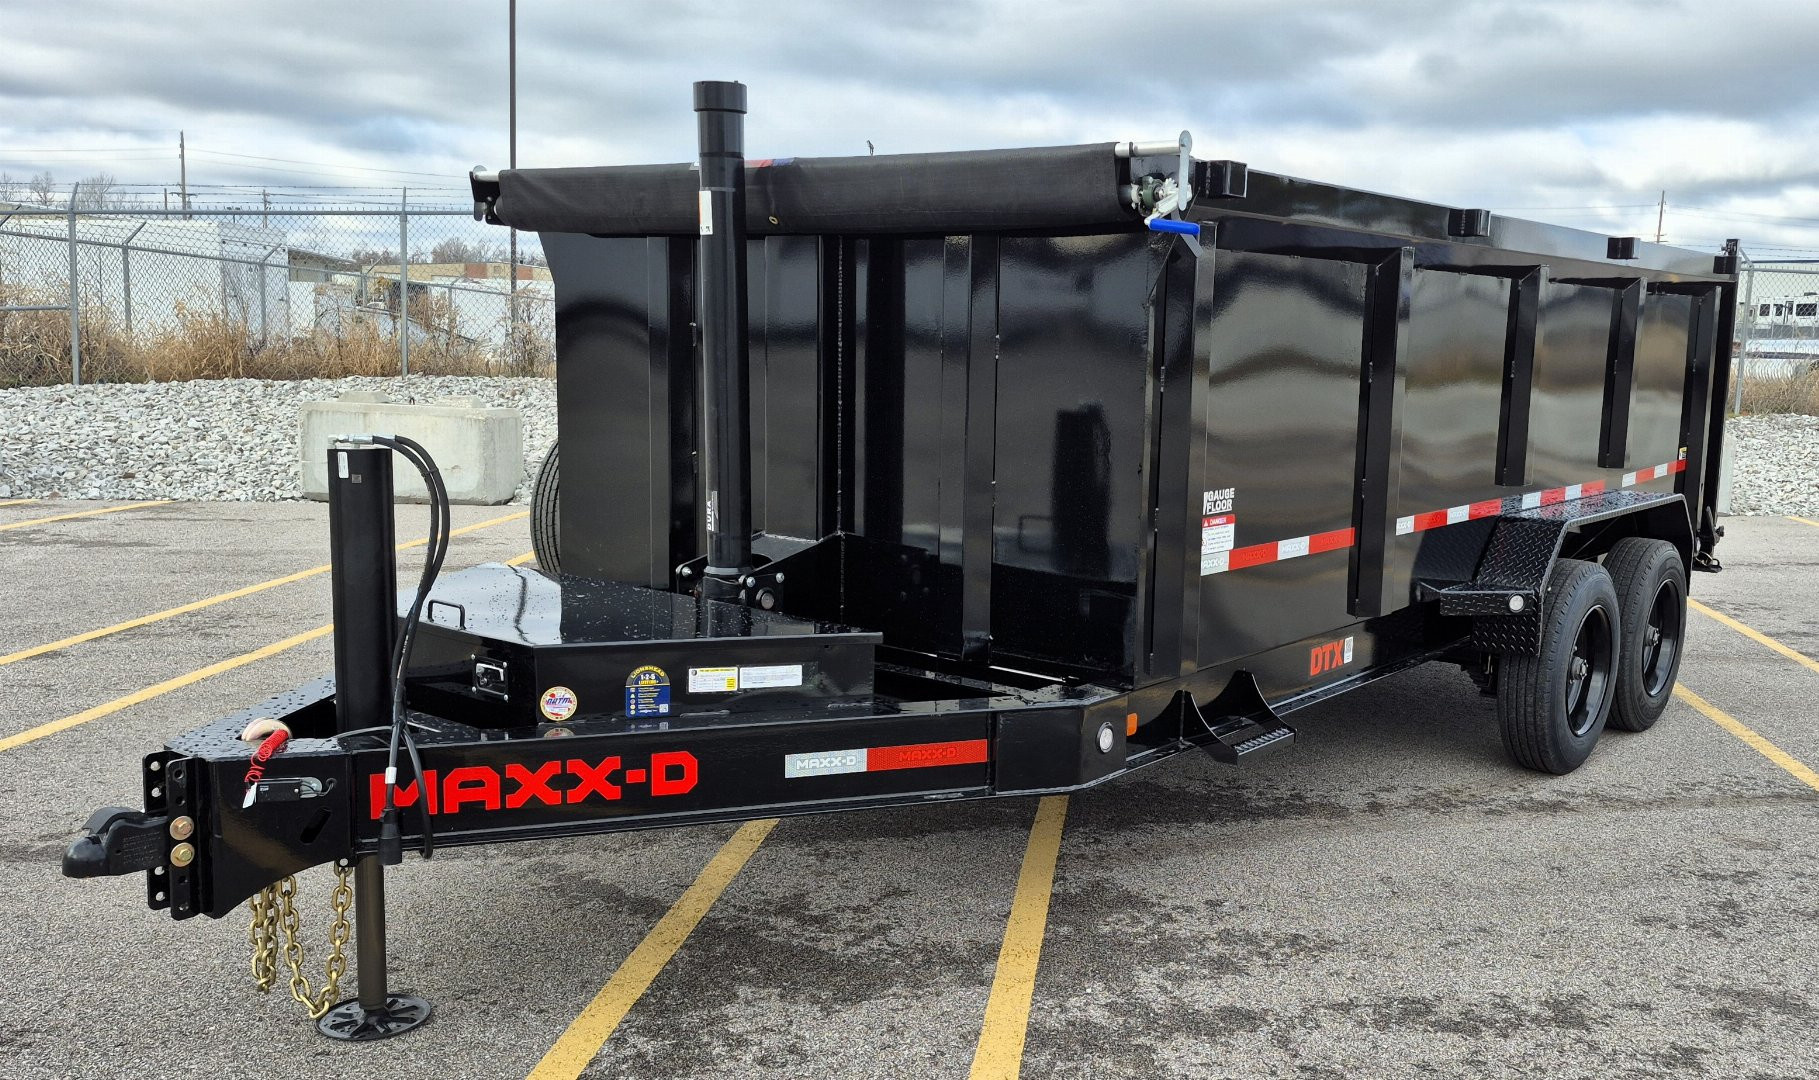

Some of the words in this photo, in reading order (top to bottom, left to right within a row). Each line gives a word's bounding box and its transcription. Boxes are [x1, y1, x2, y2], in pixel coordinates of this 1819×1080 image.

[1209, 487, 1235, 502] GAUGE
[1206, 499, 1232, 514] FLOOR
[1310, 639, 1344, 677] DTX
[899, 747, 957, 762] MAXX-D
[796, 755, 857, 770] MAXX-D
[370, 750, 698, 820] MAXX-D
